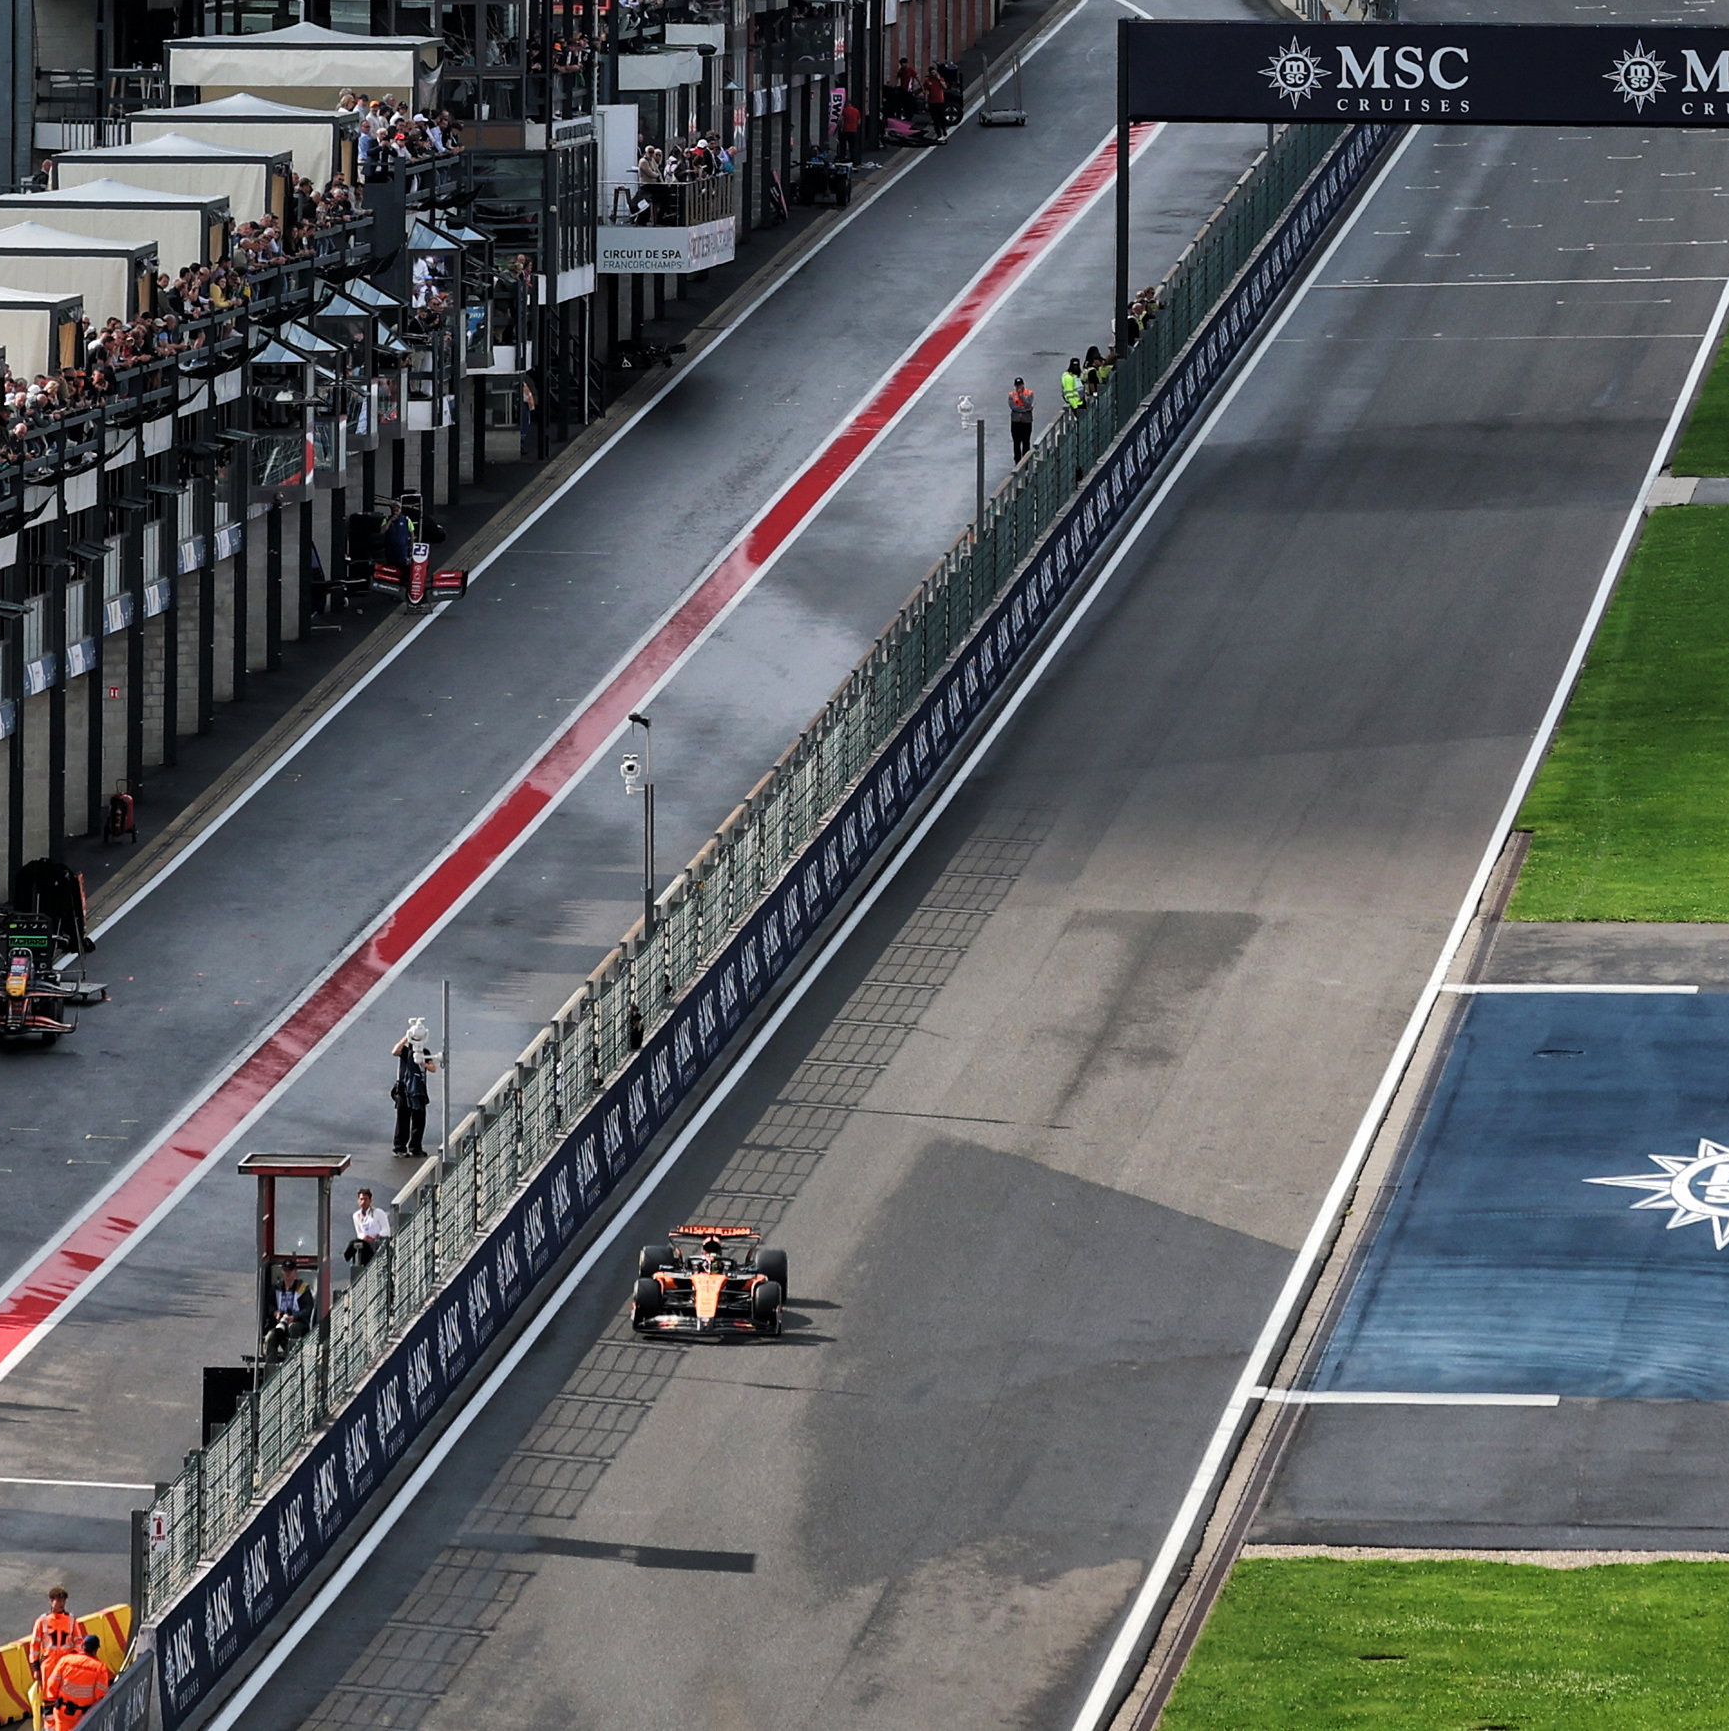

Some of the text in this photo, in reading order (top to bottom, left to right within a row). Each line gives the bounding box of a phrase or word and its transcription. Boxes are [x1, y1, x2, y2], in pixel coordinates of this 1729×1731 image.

[1335, 45, 1470, 90] MSC
[1337, 99, 1470, 112] CRUISES
[603, 249, 681, 259] CIRCUIT DE SPA
[603, 260, 681, 269] FRANCORCHAMPS
[414, 544, 428, 556] 23
[285, 1494, 305, 1555] MSC
[172, 1619, 196, 1685] MSC
